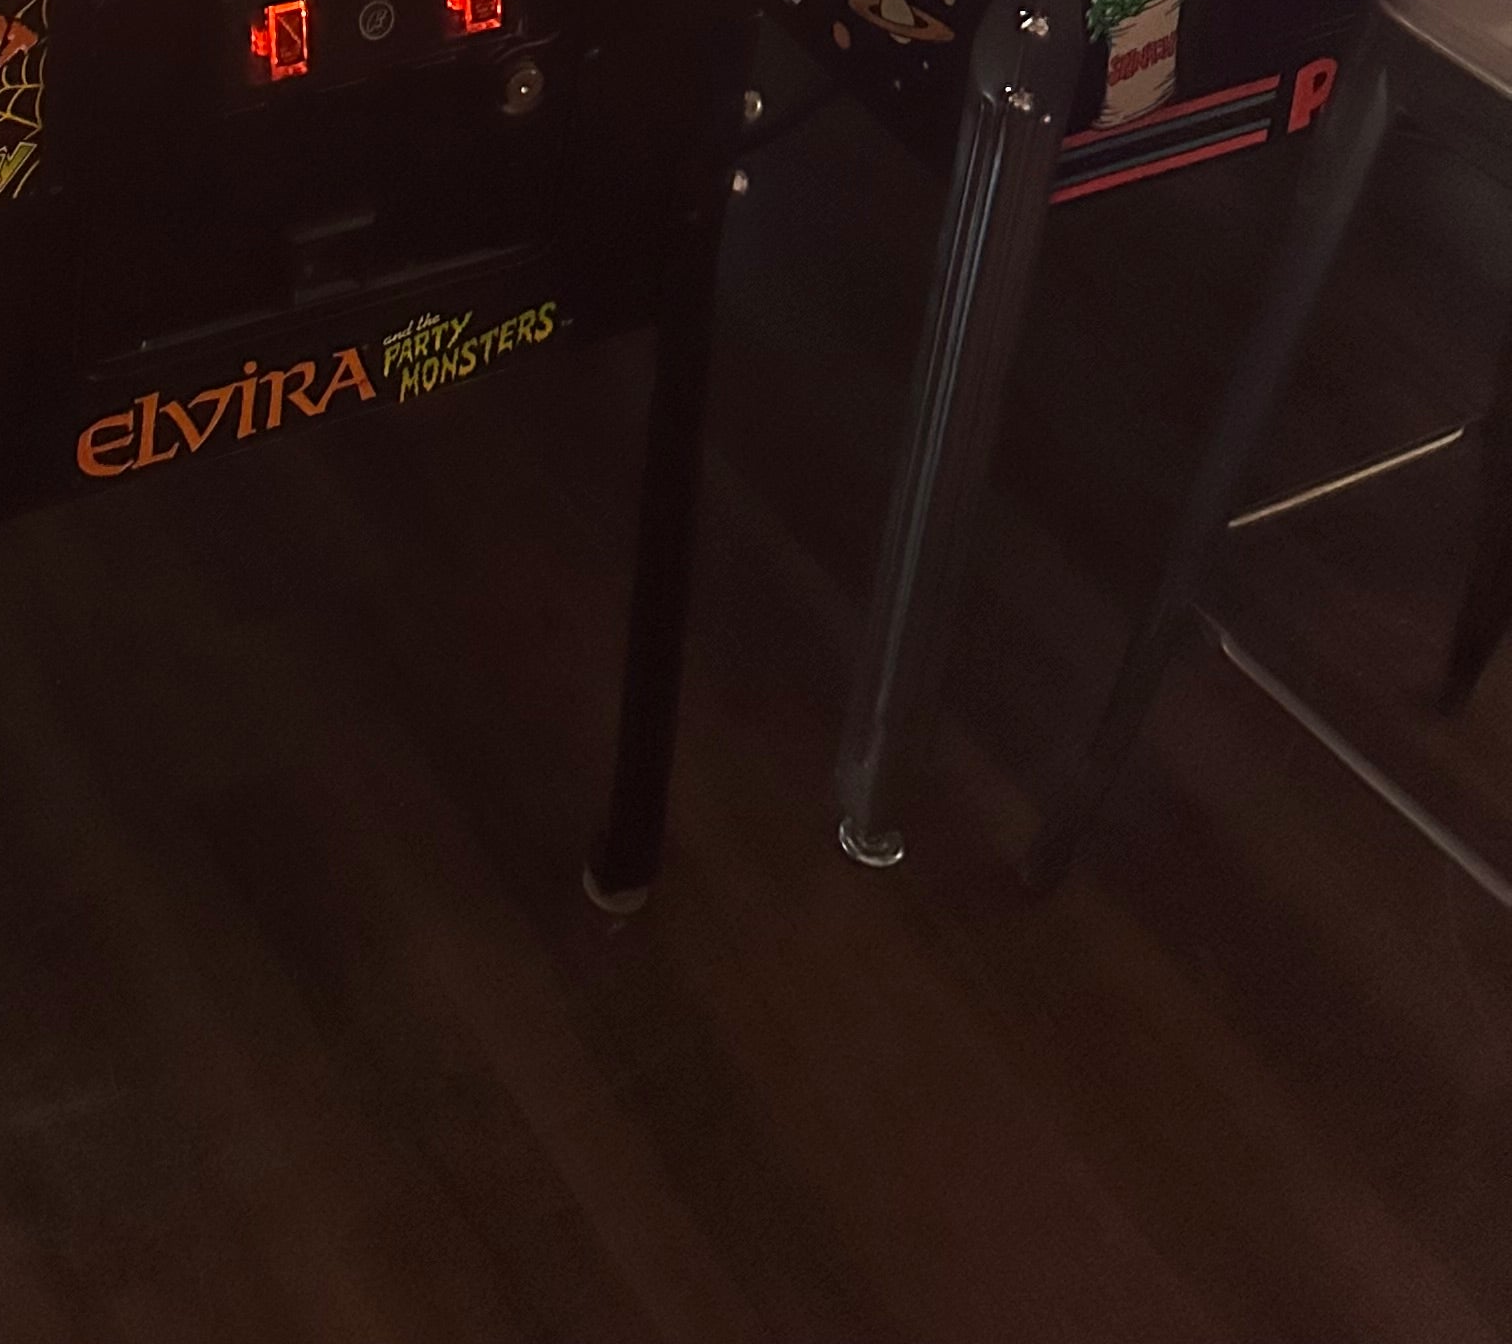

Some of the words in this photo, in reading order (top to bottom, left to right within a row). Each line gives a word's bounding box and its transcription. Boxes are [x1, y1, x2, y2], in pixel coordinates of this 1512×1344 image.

[383, 320, 414, 346] and
[416, 312, 441, 331] the
[383, 310, 473, 378] PARTY
[399, 300, 558, 404] MONSTERS
[77, 345, 377, 478] ELVIRA
